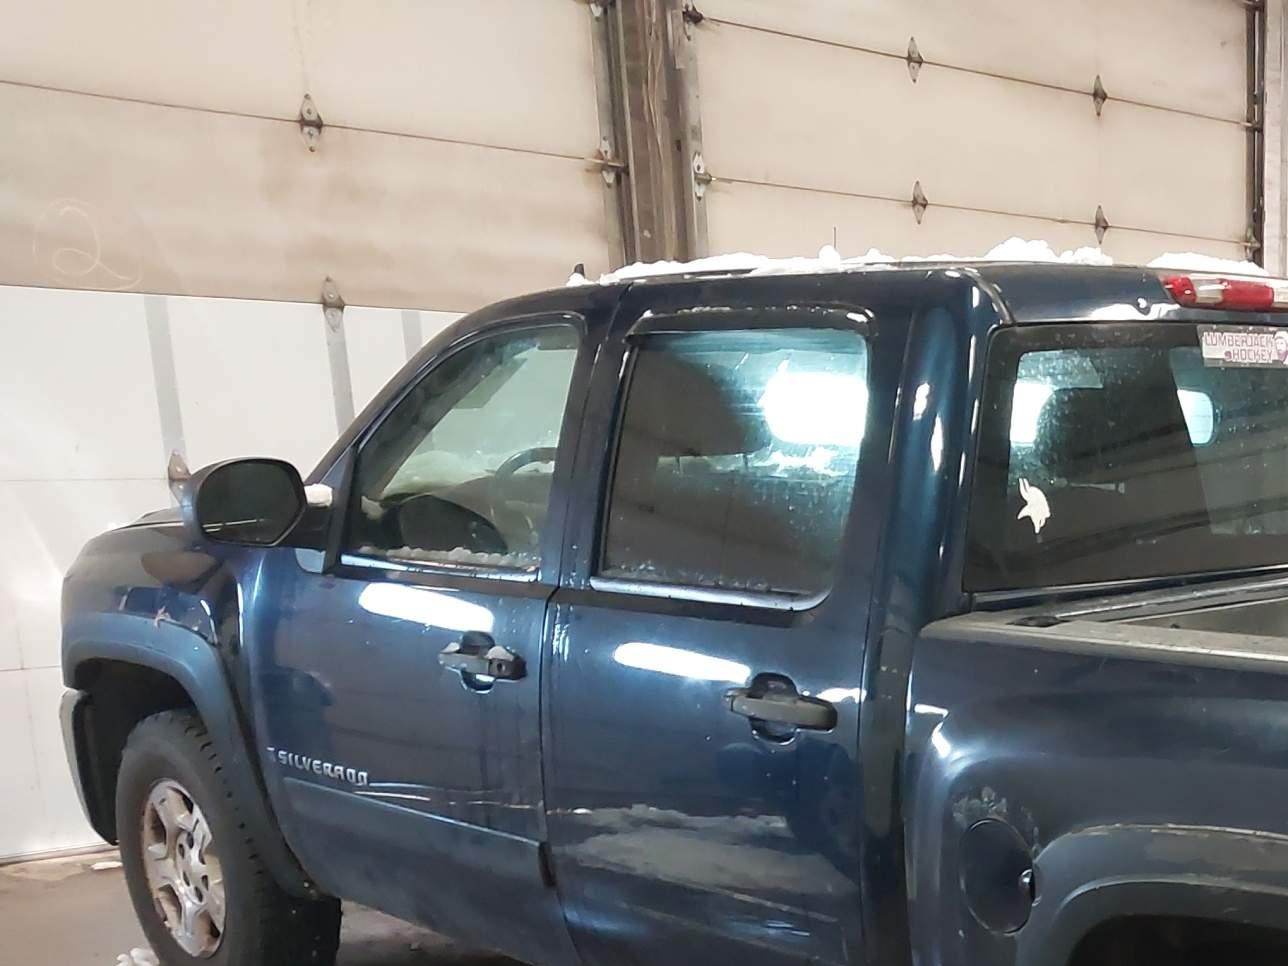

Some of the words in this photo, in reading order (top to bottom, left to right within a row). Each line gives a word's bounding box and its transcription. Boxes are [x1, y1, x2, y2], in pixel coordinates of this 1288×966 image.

[1204, 332, 1274, 348] LUMBERJACK
[1232, 348, 1273, 363] HOCKEY
[278, 749, 369, 786] SILVERADO
